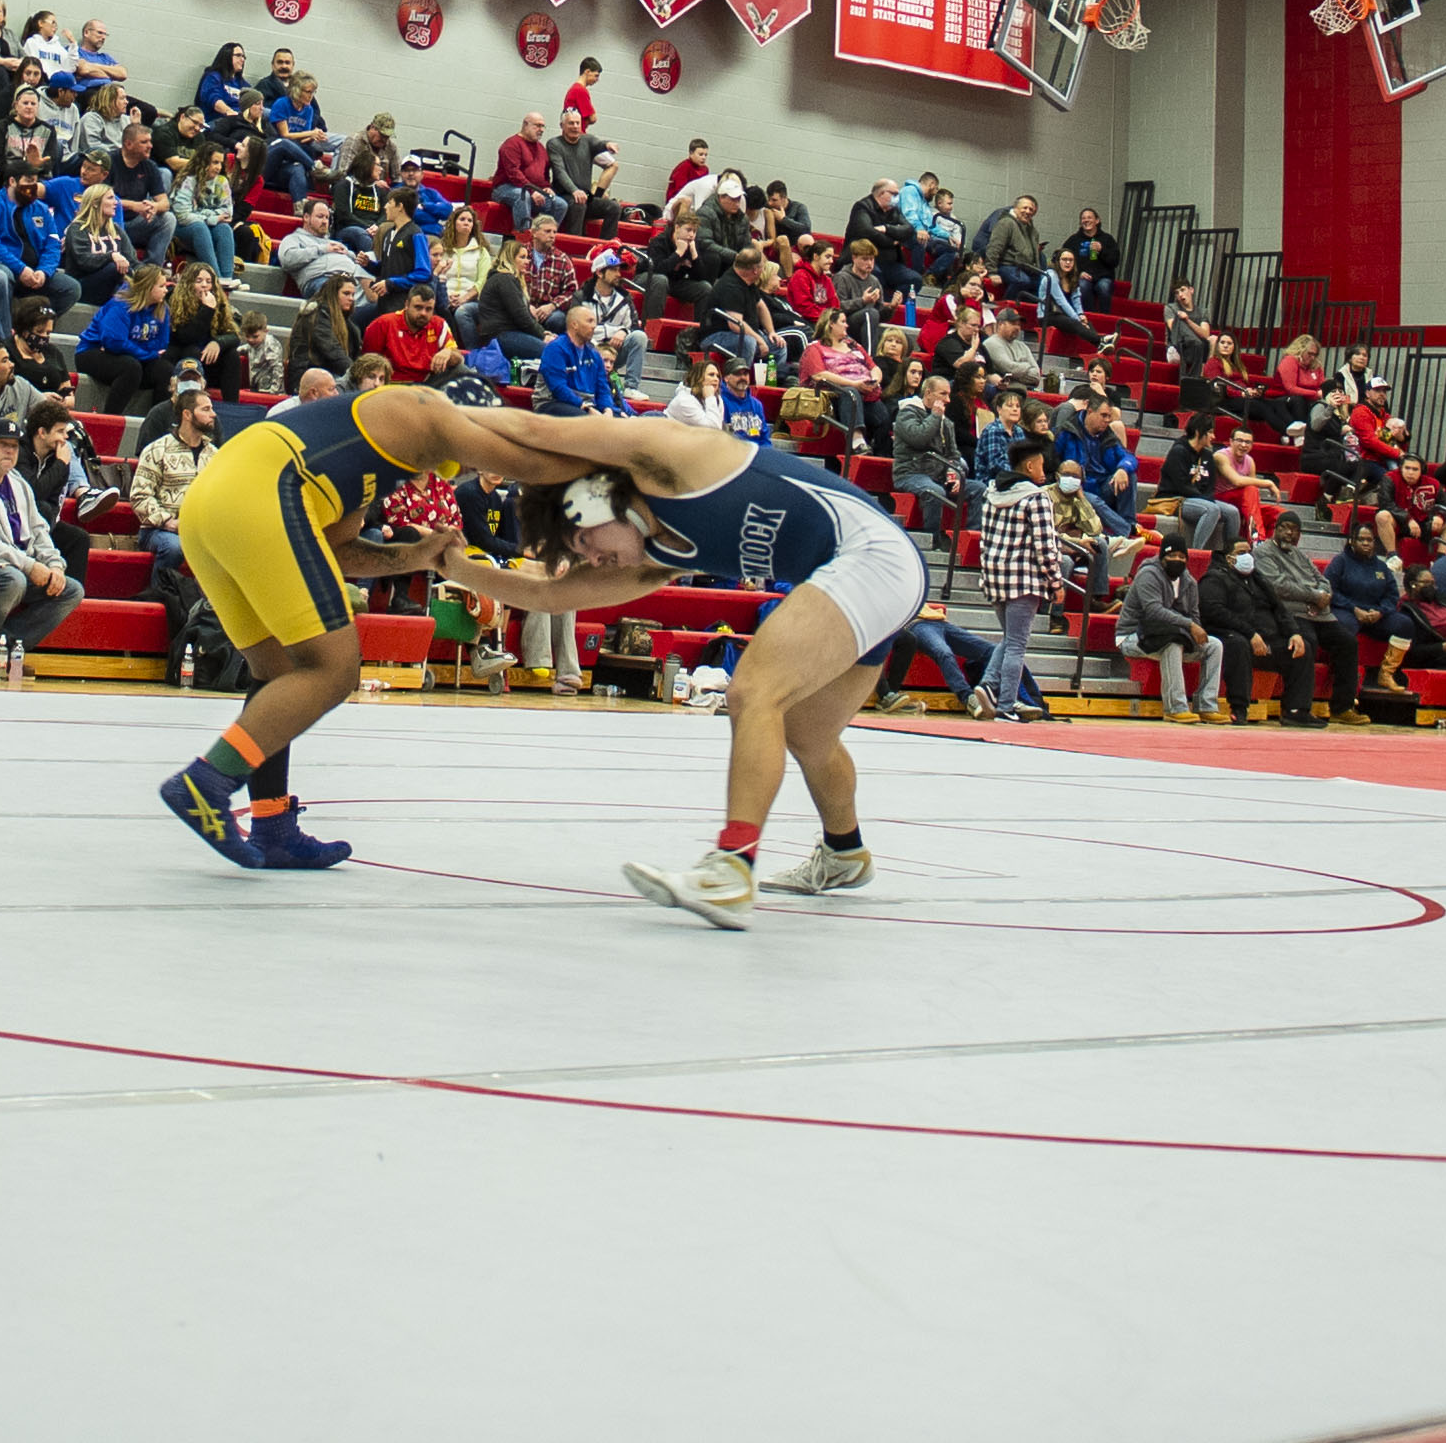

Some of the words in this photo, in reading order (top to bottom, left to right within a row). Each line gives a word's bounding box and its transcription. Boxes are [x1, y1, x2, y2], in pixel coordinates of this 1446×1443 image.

[274, 0, 299, 20] 23
[408, 10, 431, 25] Amy
[873, 8, 895, 22] STATE
[526, 45, 548, 66] 32
[650, 71, 671, 90] 33
